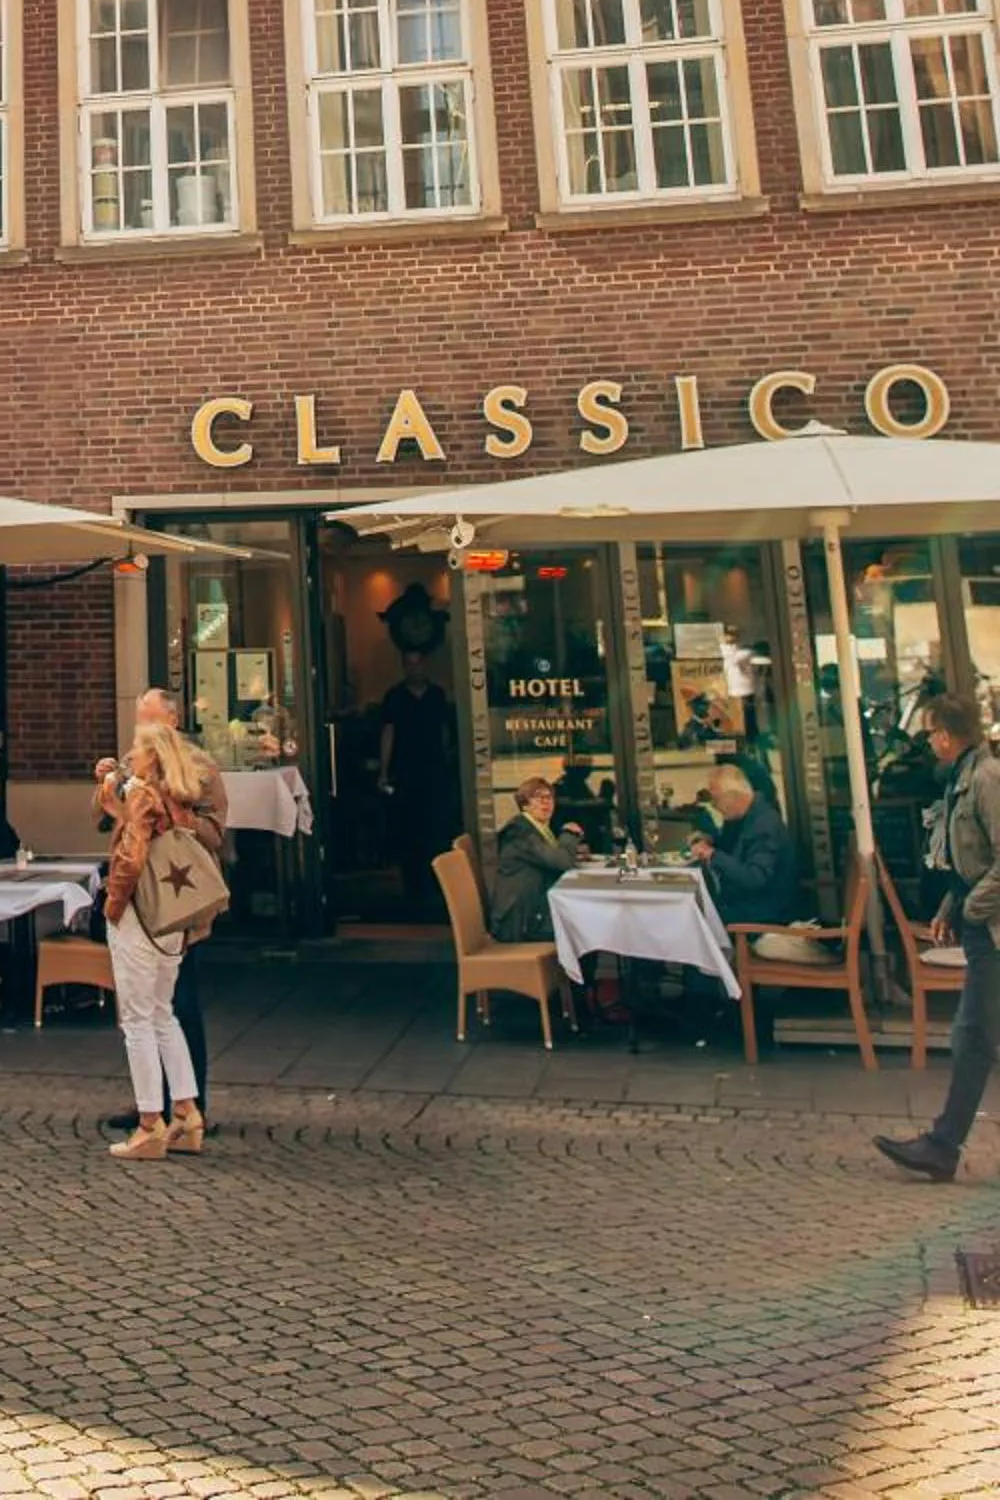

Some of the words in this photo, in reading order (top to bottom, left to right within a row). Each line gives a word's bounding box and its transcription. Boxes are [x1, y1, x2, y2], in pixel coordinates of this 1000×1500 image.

[190, 363, 952, 467] CLASSICO
[509, 678, 585, 698] HOTEL
[505, 718, 594, 732] RESTAURANT
[535, 734, 567, 748] CAFÉ
